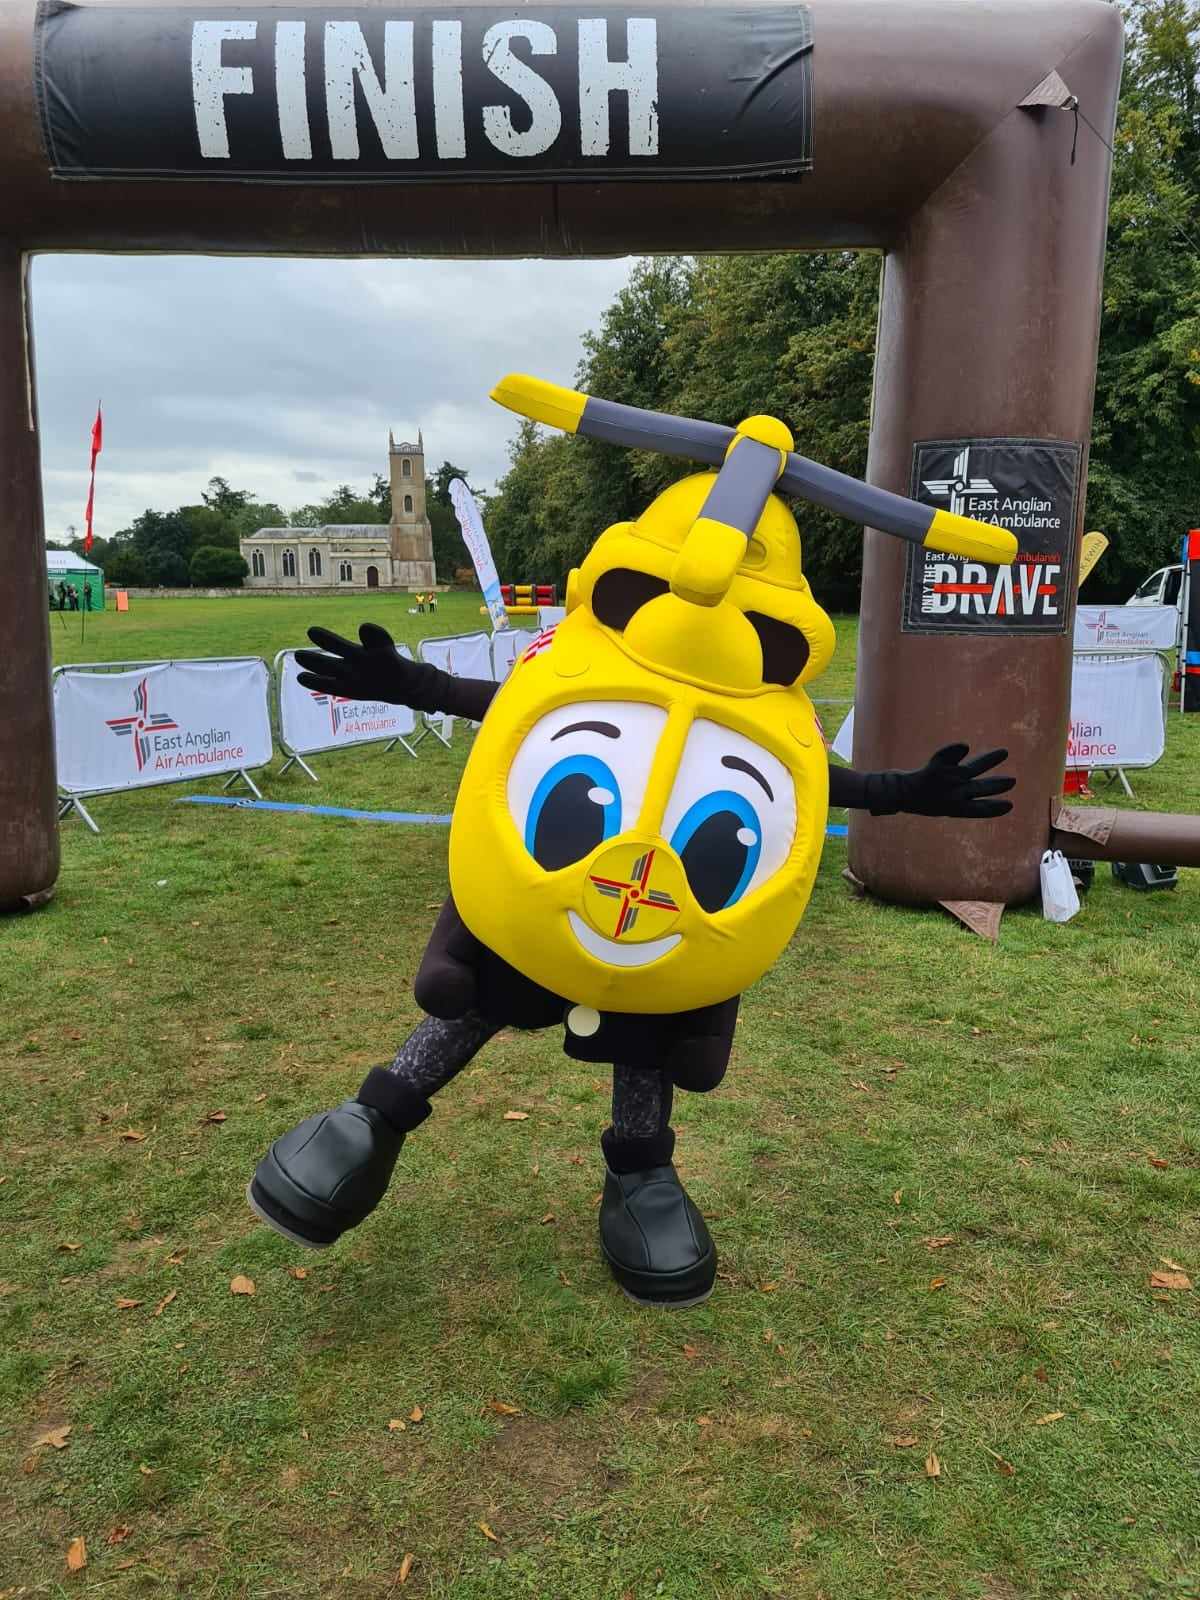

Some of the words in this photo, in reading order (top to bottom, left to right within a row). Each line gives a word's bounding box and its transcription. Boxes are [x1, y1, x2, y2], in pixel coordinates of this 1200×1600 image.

[191, 18, 660, 161] FINISH
[968, 497, 999, 511] East
[1001, 498, 1052, 515] Anglian
[990, 513, 1061, 529] Ambulance
[925, 551, 949, 562] East
[923, 563, 936, 583] THE
[921, 586, 935, 613] ONLY
[931, 563, 1061, 615] BRAVE
[153, 735, 182, 751] East
[185, 729, 231, 749] Anglian
[154, 754, 175, 770] Air
[175, 746, 245, 768] Ambulance
